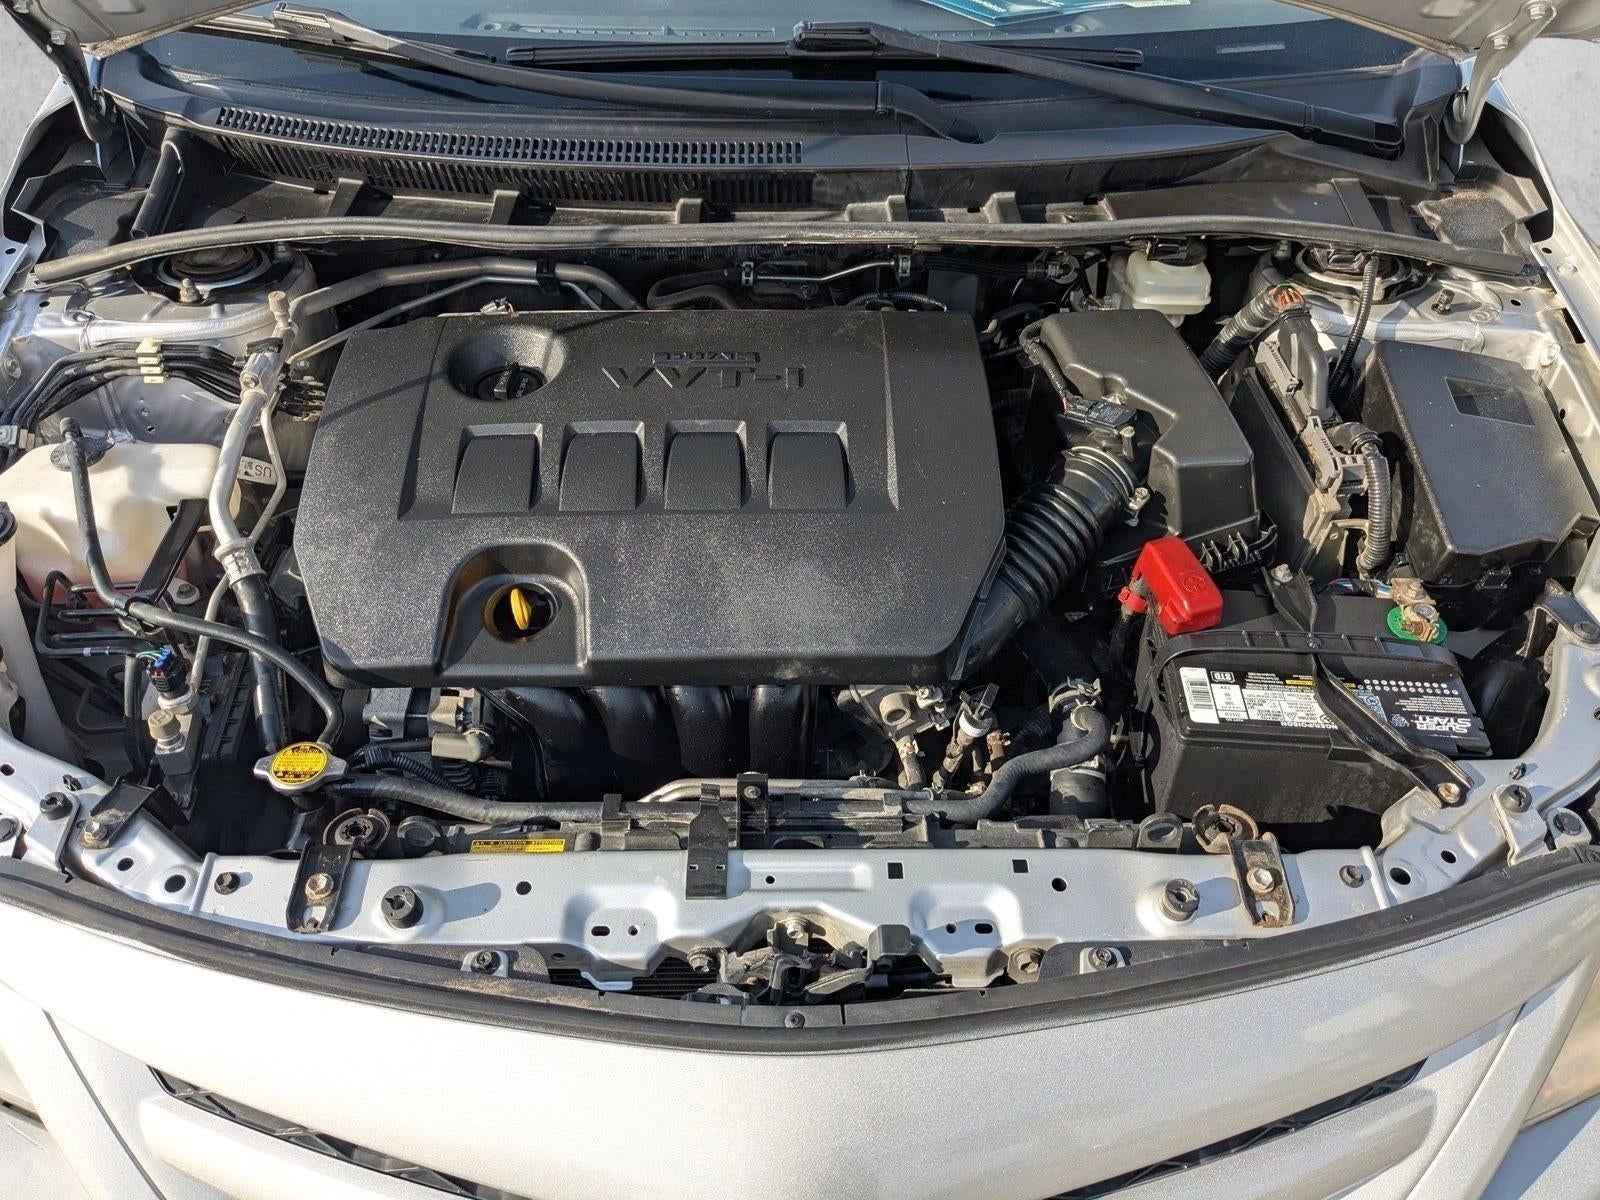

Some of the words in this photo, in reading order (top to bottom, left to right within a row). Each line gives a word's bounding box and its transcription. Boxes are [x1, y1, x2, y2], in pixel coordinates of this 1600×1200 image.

[254, 464, 272, 478] US
[1213, 672, 1233, 681] STD
[1280, 720, 1338, 730] NGER/POISON
[1414, 715, 1471, 728] START
[1416, 722, 1468, 733] SUPER
